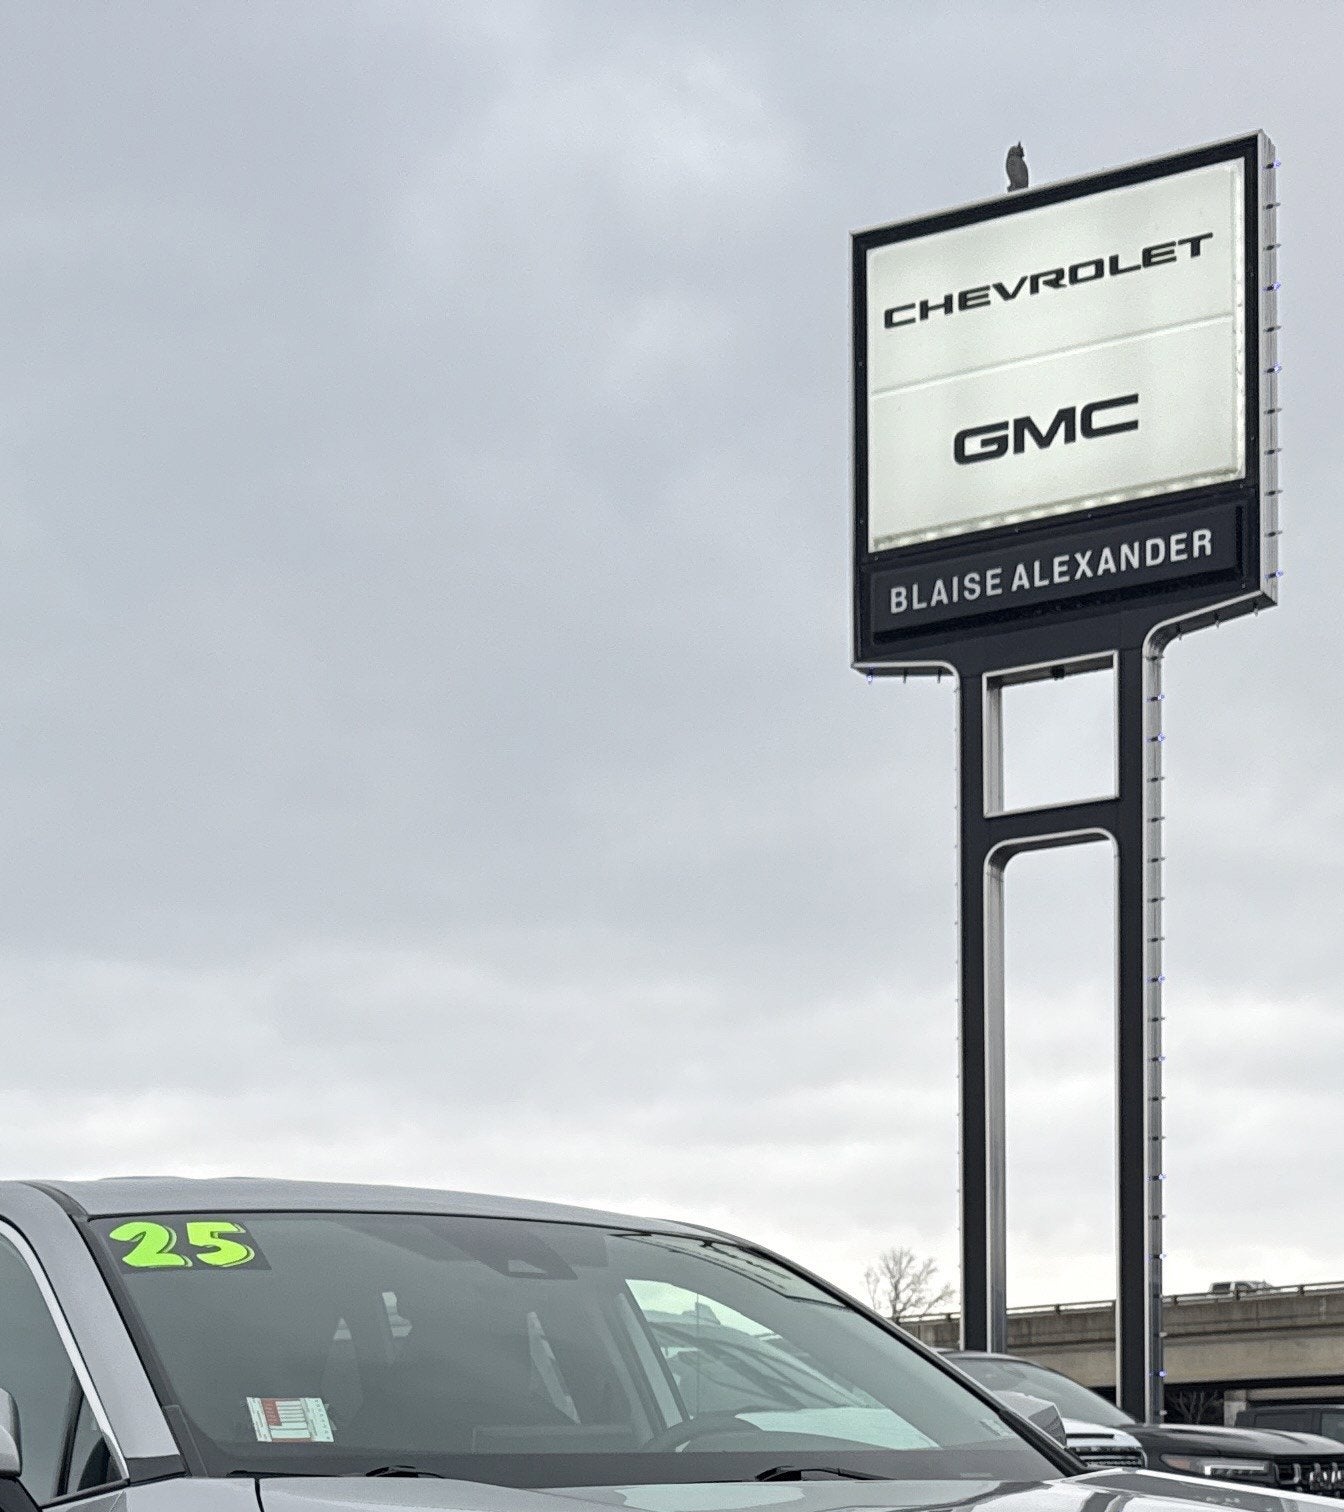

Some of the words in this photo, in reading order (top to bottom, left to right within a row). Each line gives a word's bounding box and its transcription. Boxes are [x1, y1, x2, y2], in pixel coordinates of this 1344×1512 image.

[884, 232, 1213, 329] CHEVROLET
[953, 393, 1140, 465] GMC
[890, 568, 1003, 614] BLAISE
[1011, 528, 1213, 592] ALEXANDER
[109, 1221, 255, 1268] 25
